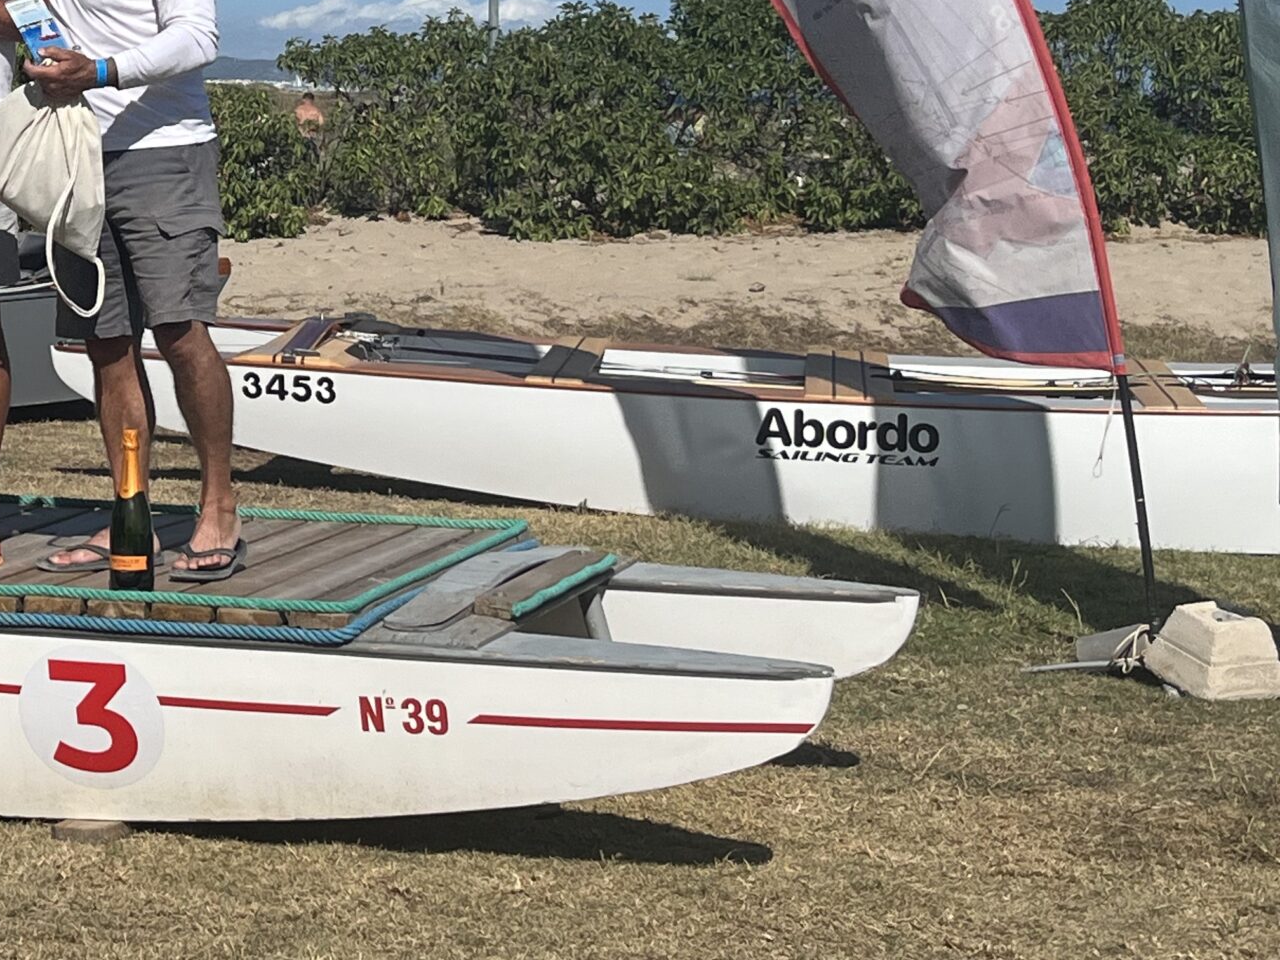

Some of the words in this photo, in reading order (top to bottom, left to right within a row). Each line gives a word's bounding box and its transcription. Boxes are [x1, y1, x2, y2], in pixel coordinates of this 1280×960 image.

[242, 371, 336, 404] 3453
[755, 407, 940, 454] Abordo
[755, 448, 860, 463] SAILING
[866, 453, 939, 467] TEAM
[47, 659, 138, 773] 3
[401, 697, 449, 735] 39
